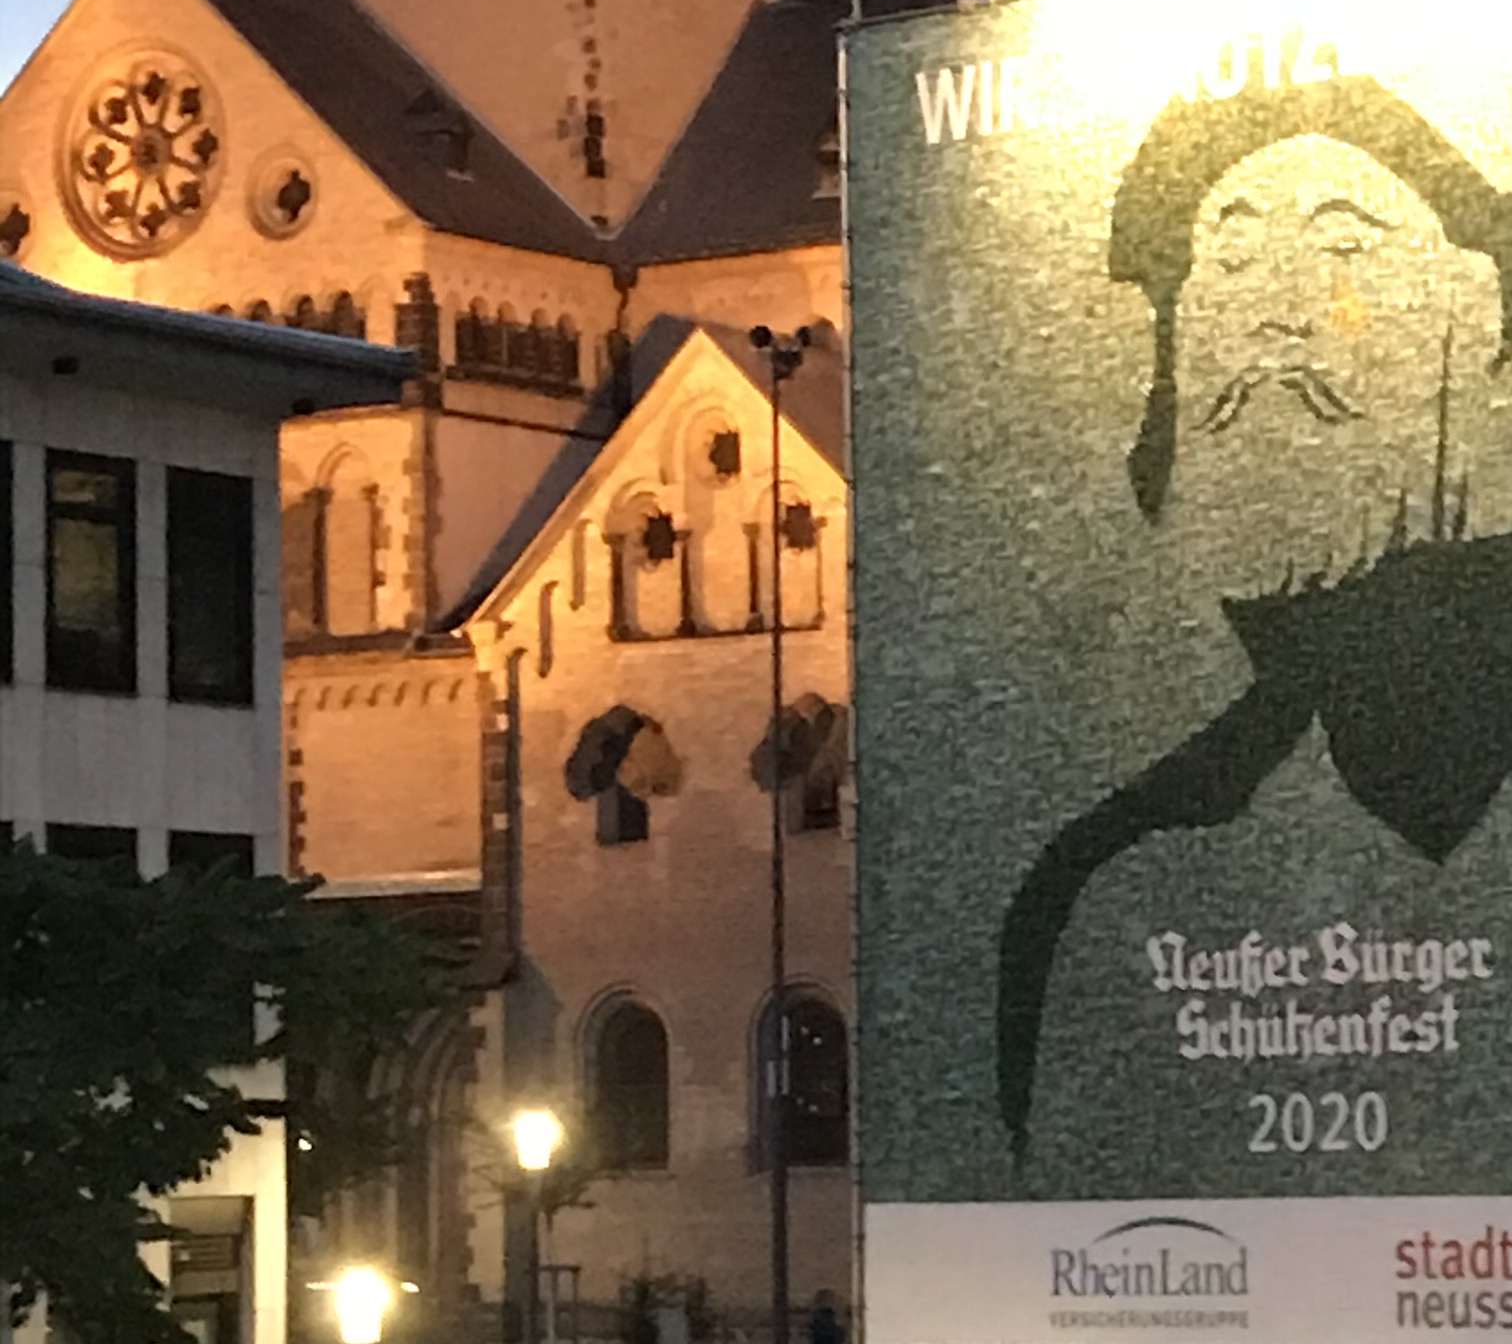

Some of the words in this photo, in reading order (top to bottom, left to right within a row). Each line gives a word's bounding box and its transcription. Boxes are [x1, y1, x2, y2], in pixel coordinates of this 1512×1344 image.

[1317, 920, 1496, 994] Bürger
[1175, 993, 1460, 1064] Schützenfest
[1247, 1090, 1389, 1154] 2020
[1050, 1244, 1250, 1298] RheinLand
